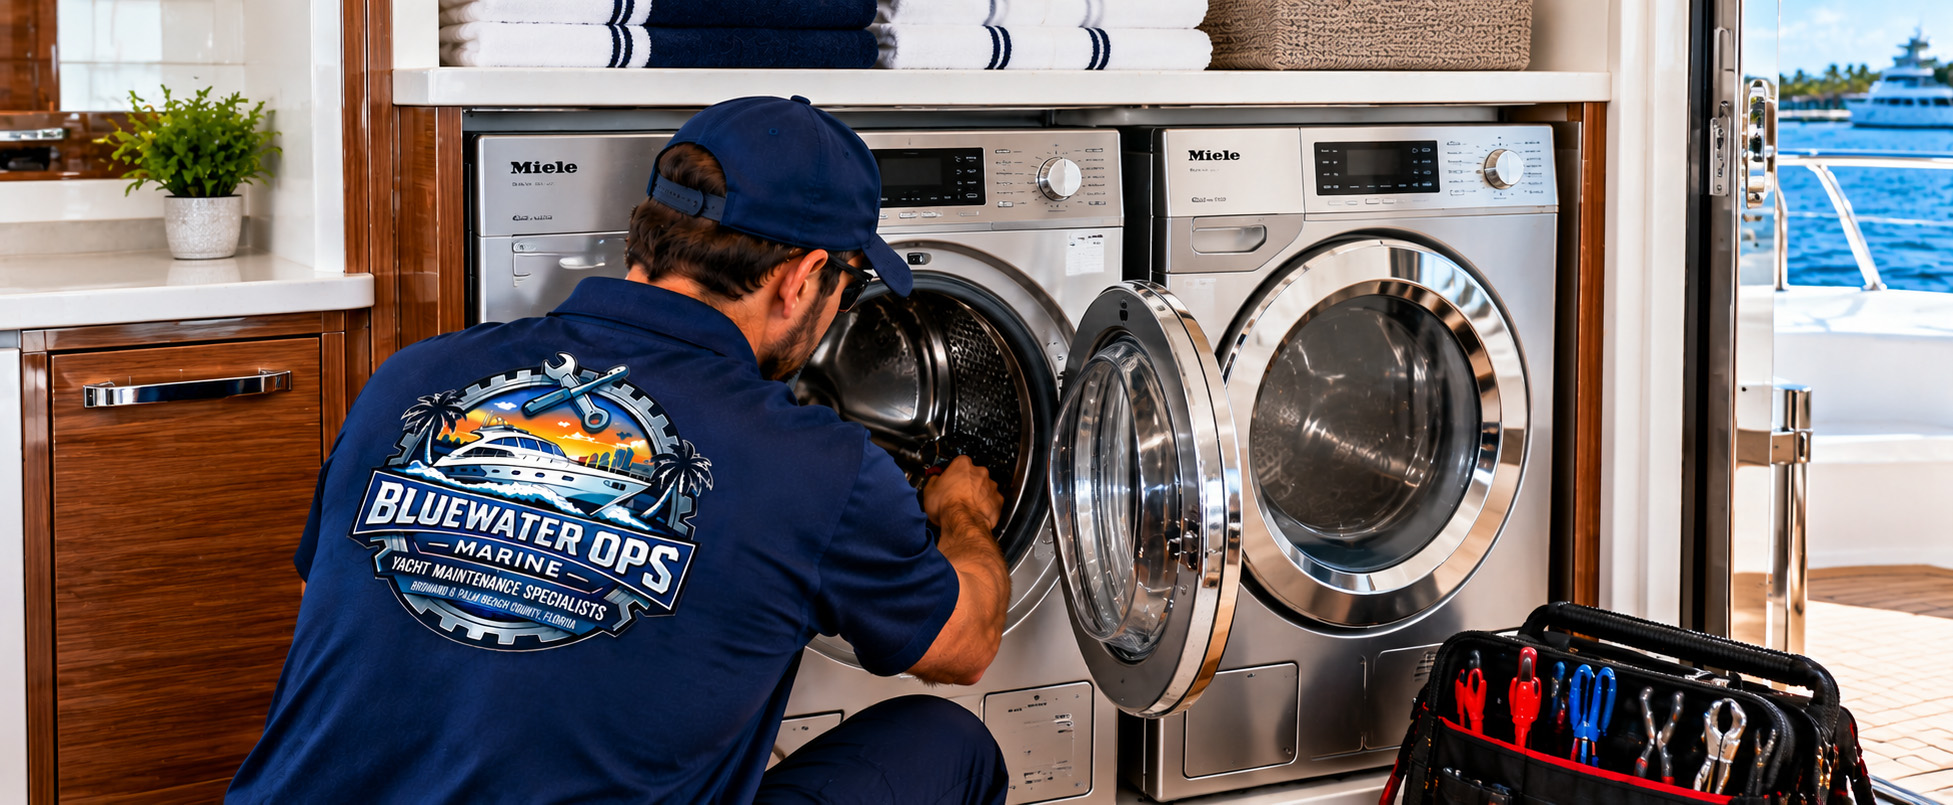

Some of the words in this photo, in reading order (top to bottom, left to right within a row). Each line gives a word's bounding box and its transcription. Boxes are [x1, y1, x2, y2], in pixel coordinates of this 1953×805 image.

[510, 161, 578, 174] Miele
[1188, 150, 1240, 161] Miele
[365, 480, 583, 555] BLUEWATER
[588, 531, 680, 595] OPS
[454, 539, 563, 578] MARINE
[391, 556, 432, 576] YACHT
[432, 563, 522, 597] MAINTENANCE
[523, 584, 608, 621] SPECIALISTS
[457, 588, 481, 602] PALM
